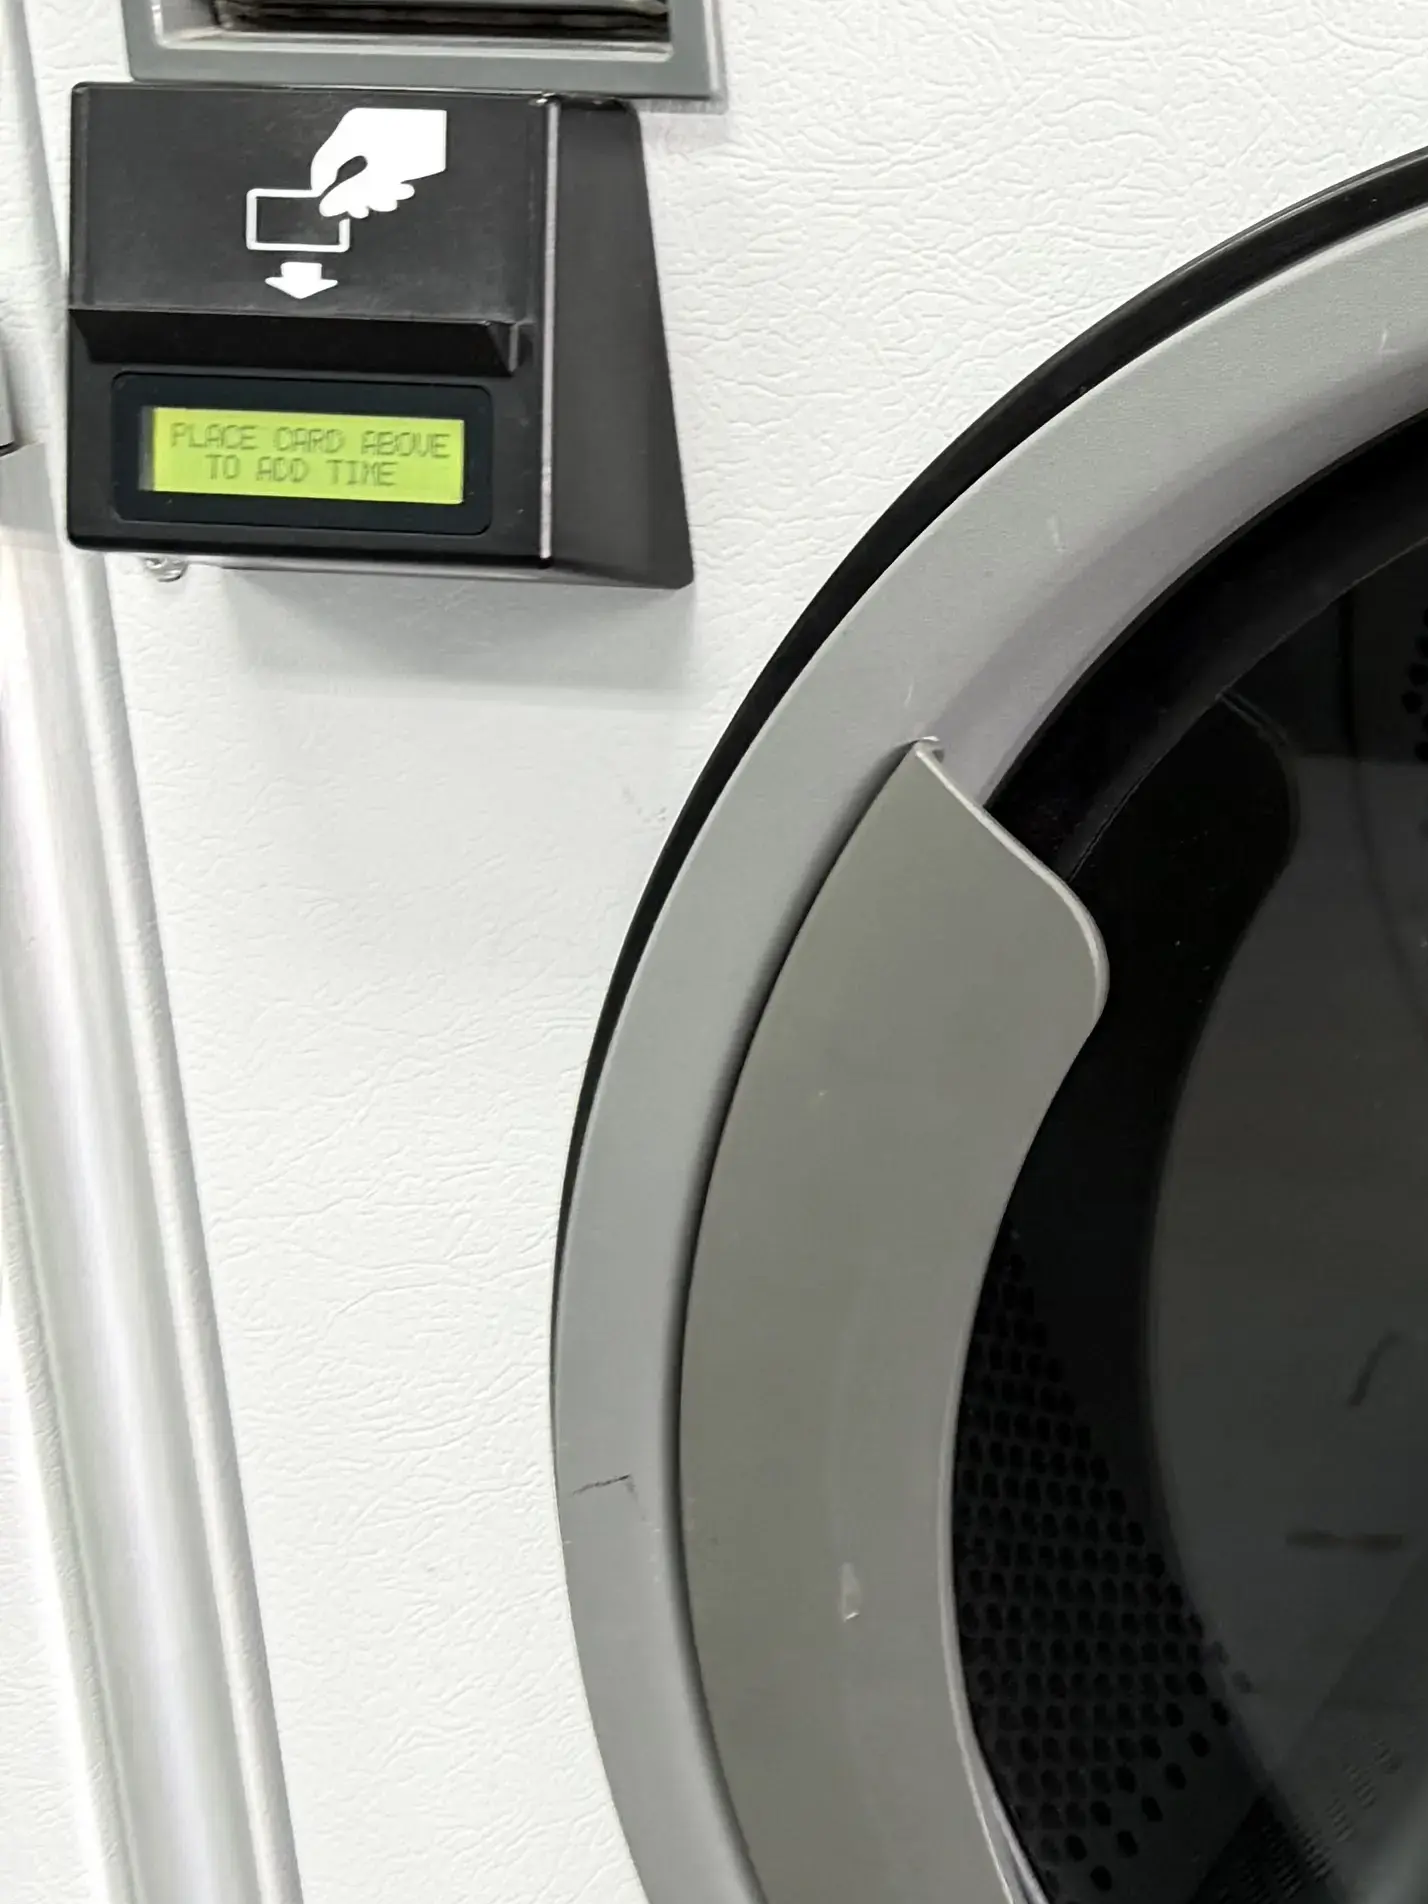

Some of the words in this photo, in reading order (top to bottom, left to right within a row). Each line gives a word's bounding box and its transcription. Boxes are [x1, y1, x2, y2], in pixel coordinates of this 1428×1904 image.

[170, 422, 258, 451] PLACE
[273, 426, 346, 454] CARD
[360, 430, 451, 459] ABOVE
[204, 453, 240, 480] TO
[255, 456, 309, 483] ADD
[327, 459, 397, 487] TIME
